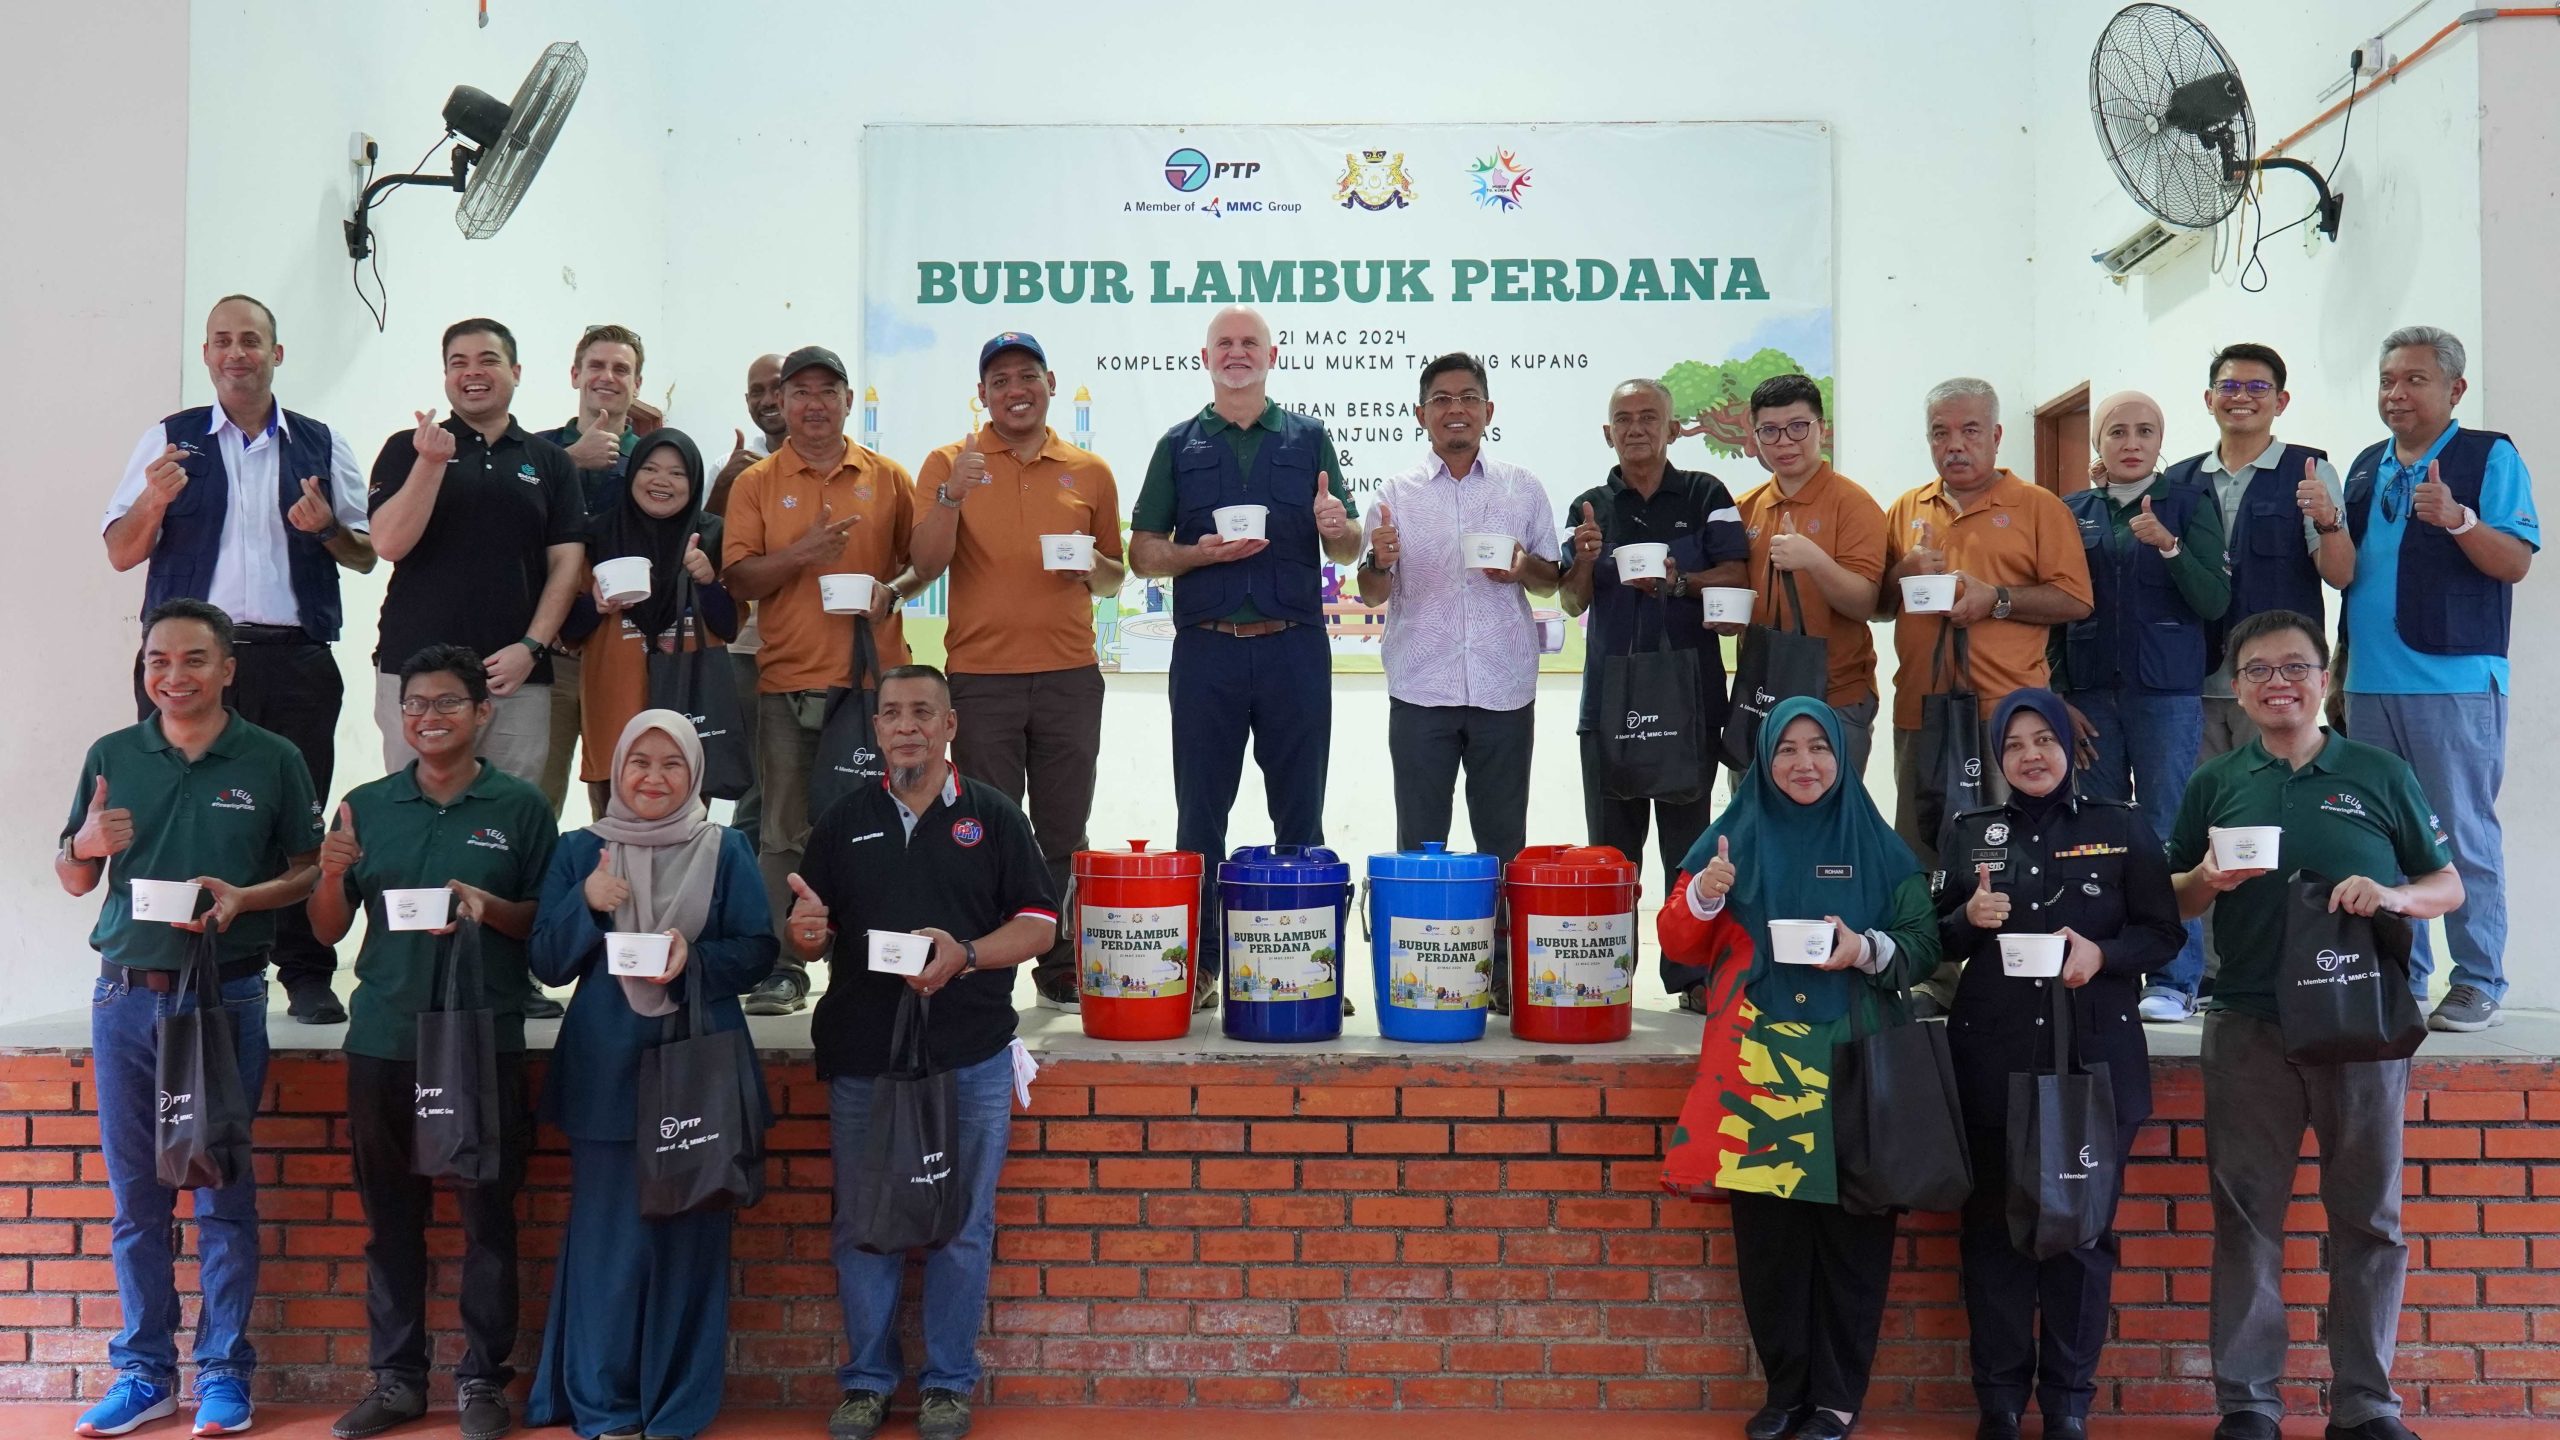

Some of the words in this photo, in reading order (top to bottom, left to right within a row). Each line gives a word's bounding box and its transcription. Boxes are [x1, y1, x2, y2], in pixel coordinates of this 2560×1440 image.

[1214, 162, 1261, 179] PTP
[1123, 202, 1132, 212] A
[1136, 201, 1180, 212] Member
[1184, 201, 1195, 212] of
[1226, 201, 1263, 212] MMC
[1268, 202, 1302, 215] Group
[917, 260, 1134, 304] BUBUR
[1150, 259, 1434, 304] LAMBUK
[1452, 257, 1770, 302] PERDANA
[1306, 330, 1347, 345] MAC
[1359, 330, 1406, 345] 2024
[1097, 355, 1201, 371] KOMPLEKS
[1326, 354, 1394, 370] MUKIM
[1511, 353, 1589, 369] KUPANG
[1339, 449, 1353, 466] &
[1641, 714, 1659, 723] PTP
[1086, 927, 1122, 940] BUBUR
[1126, 927, 1179, 940] LAMBUK
[1234, 932, 1271, 943] BUBUR
[1274, 929, 1327, 942] LAMBUK
[1101, 940, 1162, 951] PERDANA
[1249, 942, 1311, 954] PERDANA
[1398, 939, 1441, 952] BUBUR
[1444, 939, 1489, 952] LAMBUK
[1536, 936, 1579, 948] BUBUR
[1581, 935, 1627, 948] LAMBUK
[1416, 952, 1476, 963] PERDANA
[1554, 948, 1615, 959] PERDANA
[2338, 953, 2360, 964] PTP
[2303, 976, 2328, 986] Member
[2348, 972, 2368, 982] MMC
[172, 1093, 192, 1105] PTP
[421, 1087, 443, 1098] PTP
[680, 1117, 702, 1130] PTP
[689, 1135, 707, 1146] MMC
[923, 1151, 944, 1165] PTP
[2063, 1172, 2088, 1180] Member
